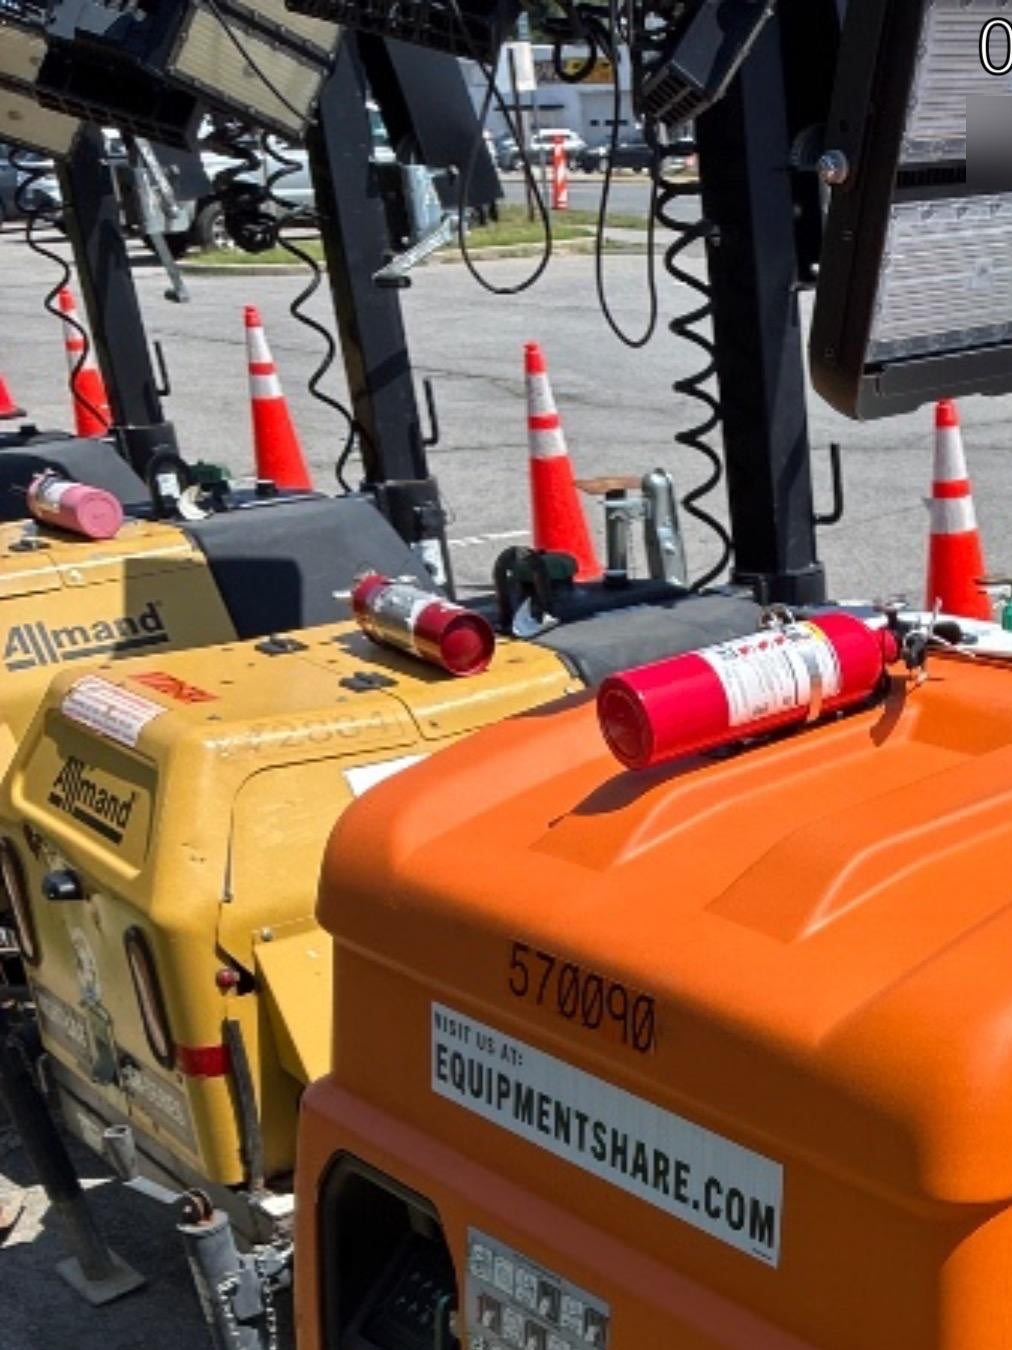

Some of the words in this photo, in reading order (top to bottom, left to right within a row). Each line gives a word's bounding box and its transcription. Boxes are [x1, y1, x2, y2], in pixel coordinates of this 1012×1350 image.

[4, 600, 167, 669] Allmand
[52, 755, 137, 829] Allmand
[508, 942, 657, 1053] 570090
[476, 1031, 496, 1054] US
[500, 1043, 523, 1066] AT:
[436, 1043, 775, 1246] EQUIPMENTSHARE.COM
